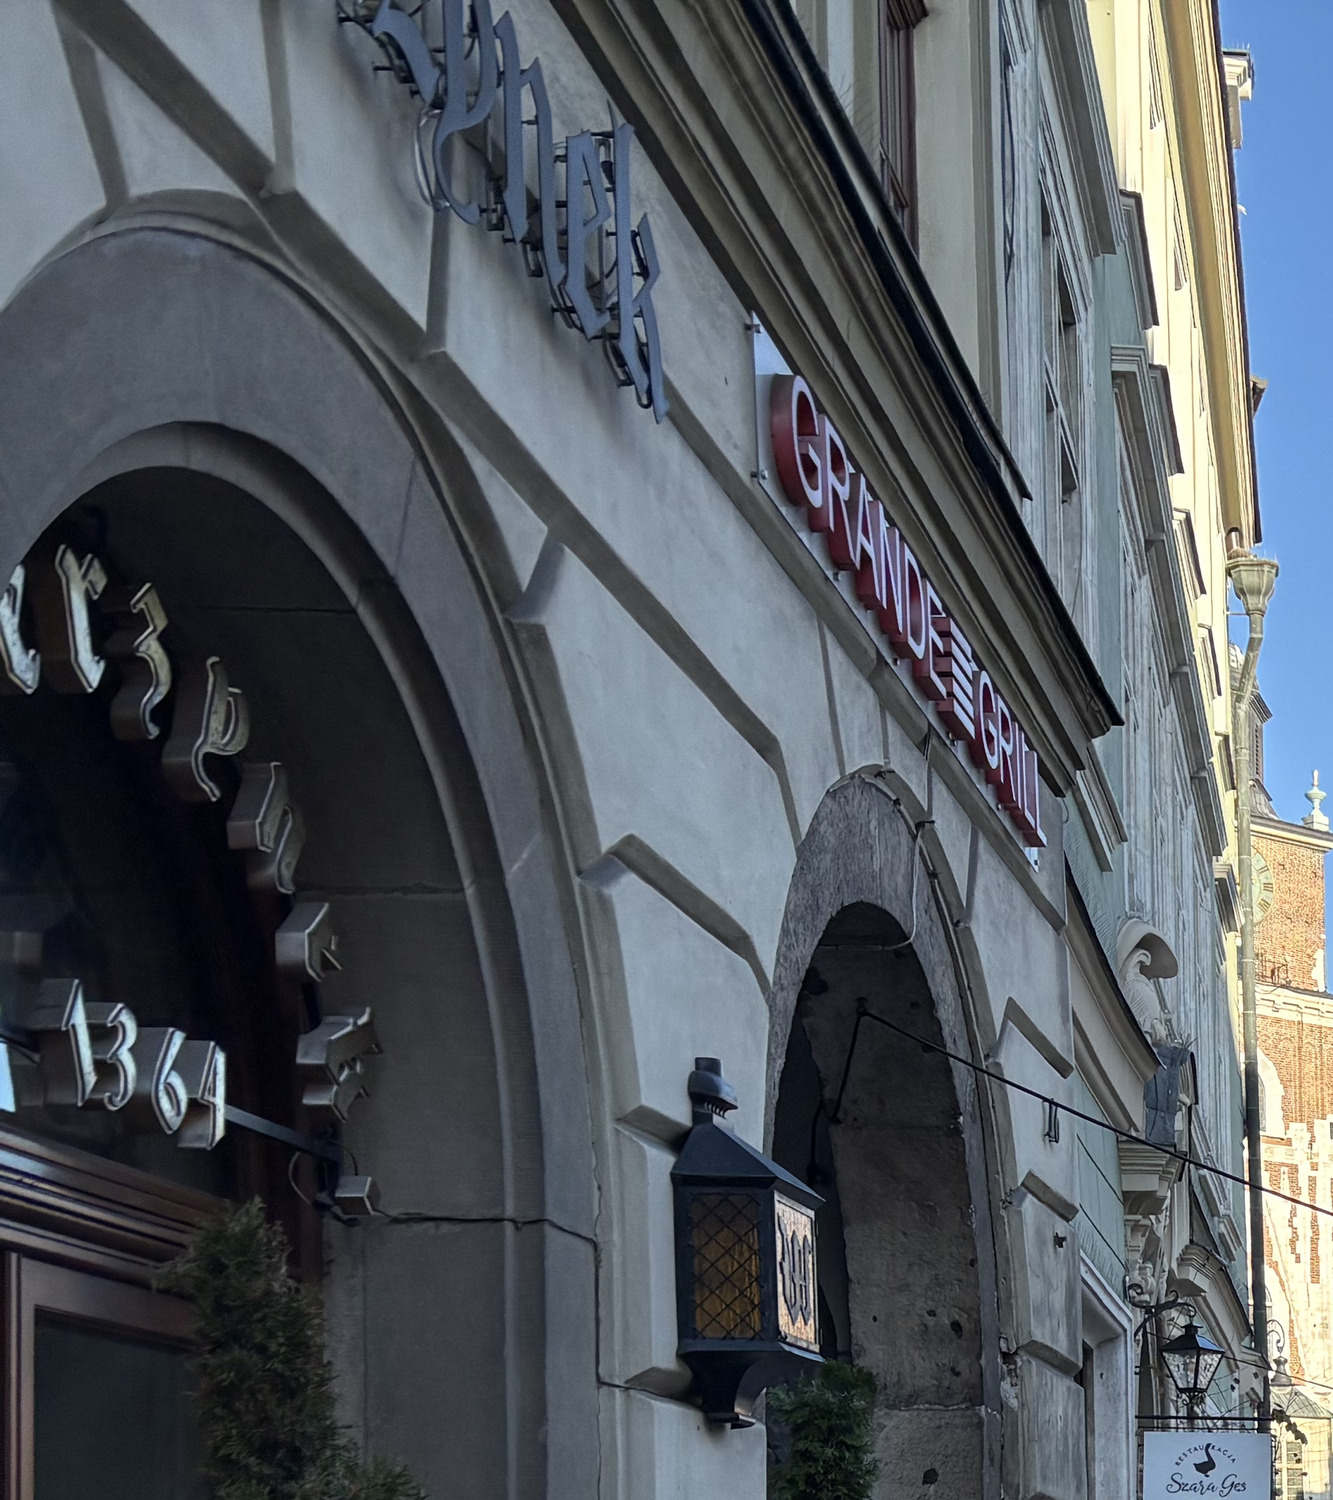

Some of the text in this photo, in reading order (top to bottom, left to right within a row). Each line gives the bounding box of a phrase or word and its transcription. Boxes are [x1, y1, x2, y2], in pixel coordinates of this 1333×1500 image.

[773, 375, 1047, 848] GRANDE GRILL
[61, 978, 227, 1152] 1364
[1165, 1472, 1218, 1496] Szara
[1174, 1444, 1237, 1467] RESTAURACJA
